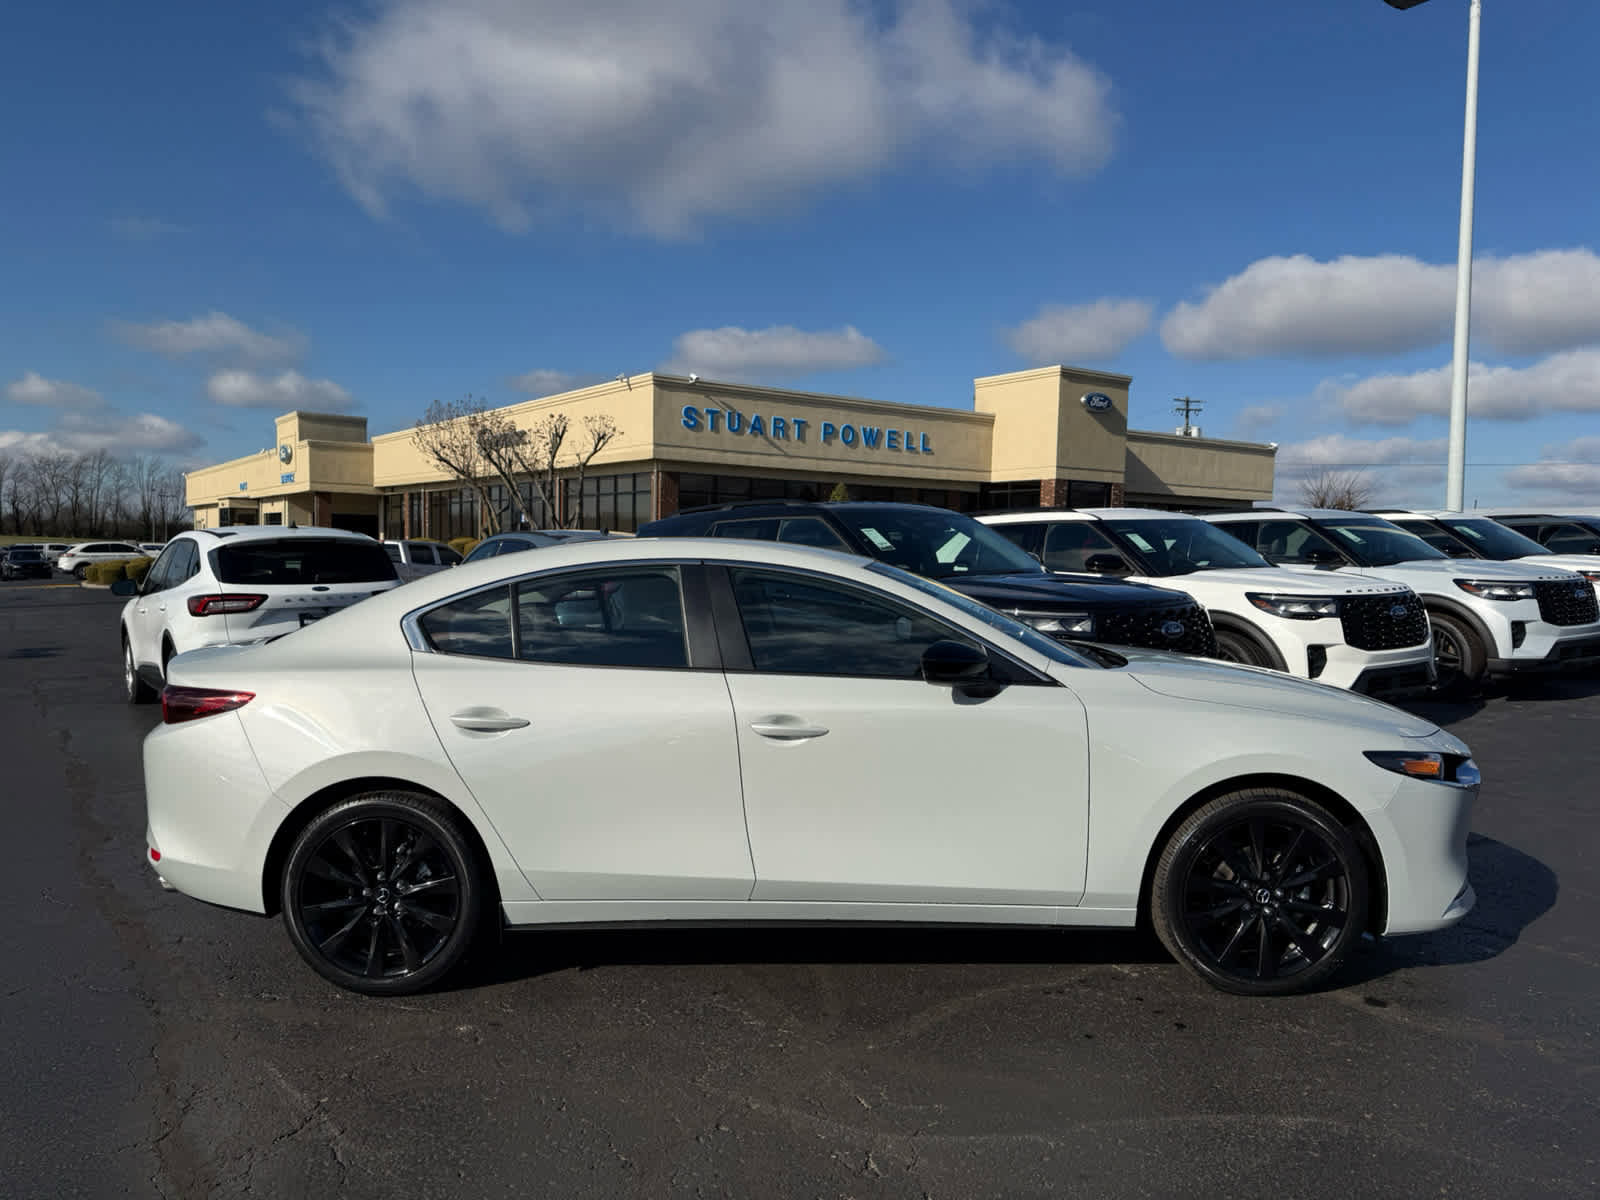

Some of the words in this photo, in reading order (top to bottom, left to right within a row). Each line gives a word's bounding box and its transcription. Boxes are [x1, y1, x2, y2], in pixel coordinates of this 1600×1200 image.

[1089, 395, 1110, 409] Ford
[681, 404, 807, 441] STUART
[820, 421, 933, 452] POWELL
